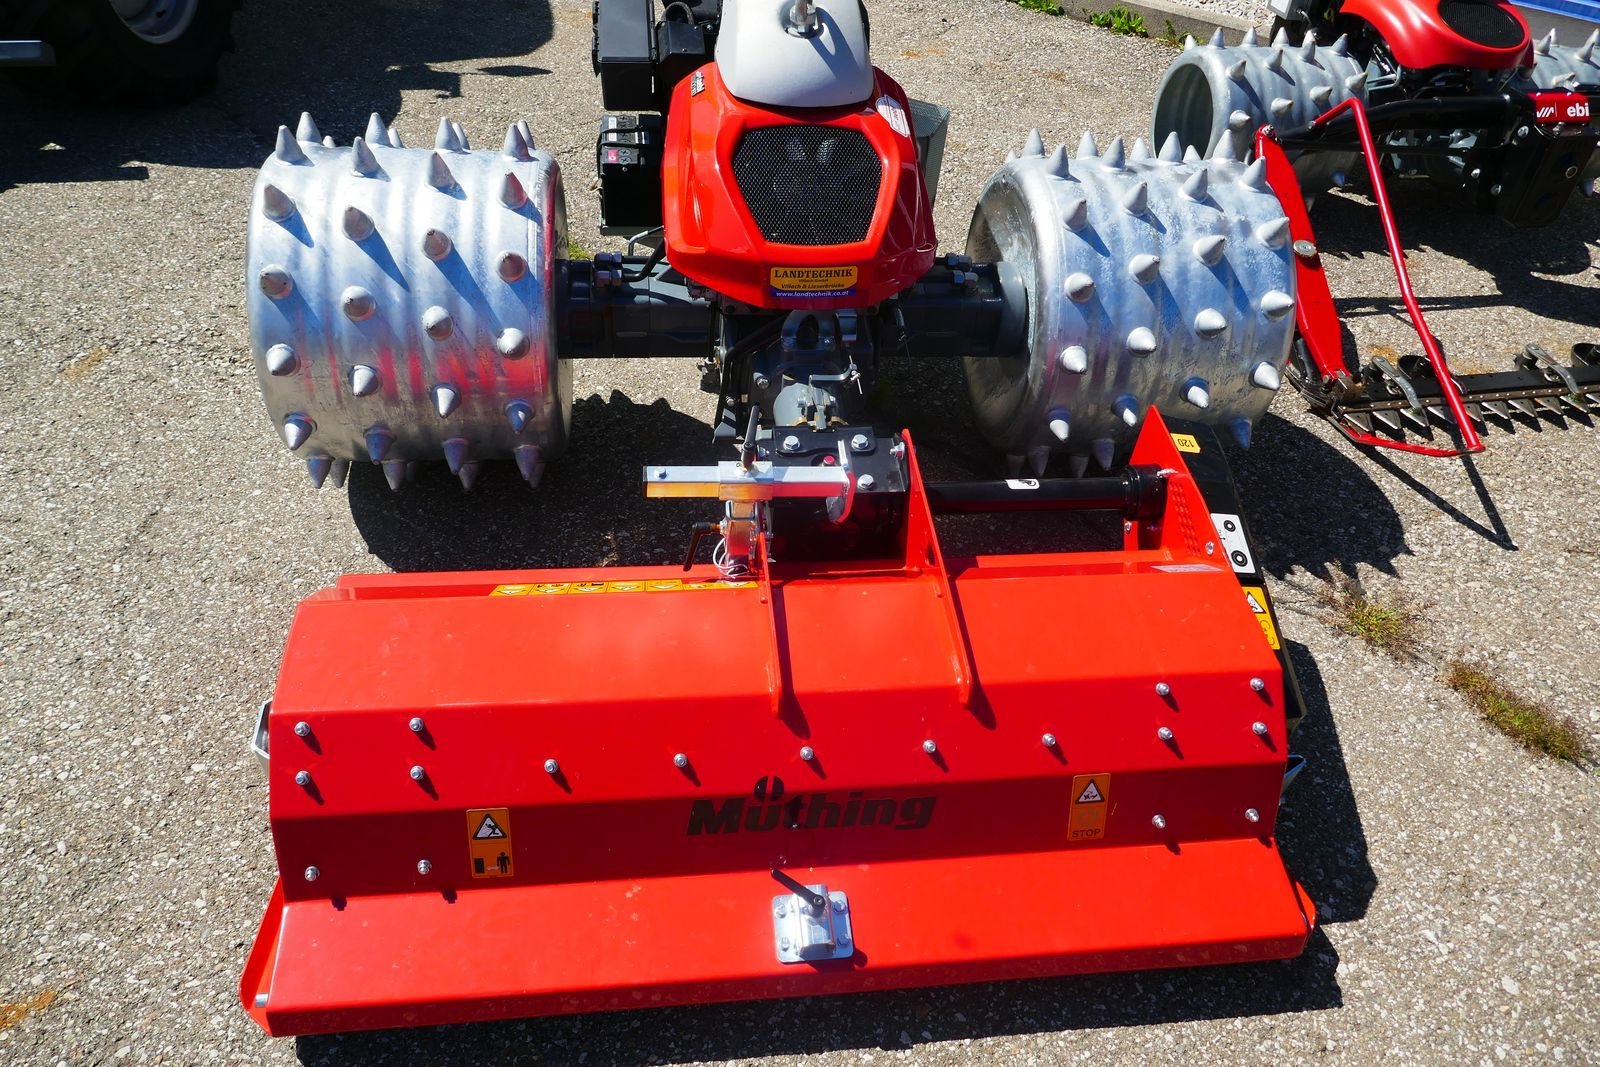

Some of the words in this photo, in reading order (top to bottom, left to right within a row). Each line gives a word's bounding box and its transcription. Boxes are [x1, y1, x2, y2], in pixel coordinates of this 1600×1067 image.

[1567, 102, 1589, 117] ebi
[774, 268, 853, 279] LANDTECHNIK
[1177, 438, 1195, 448] 120
[686, 775, 937, 837] Müthing
[1072, 828, 1101, 838] STOP
